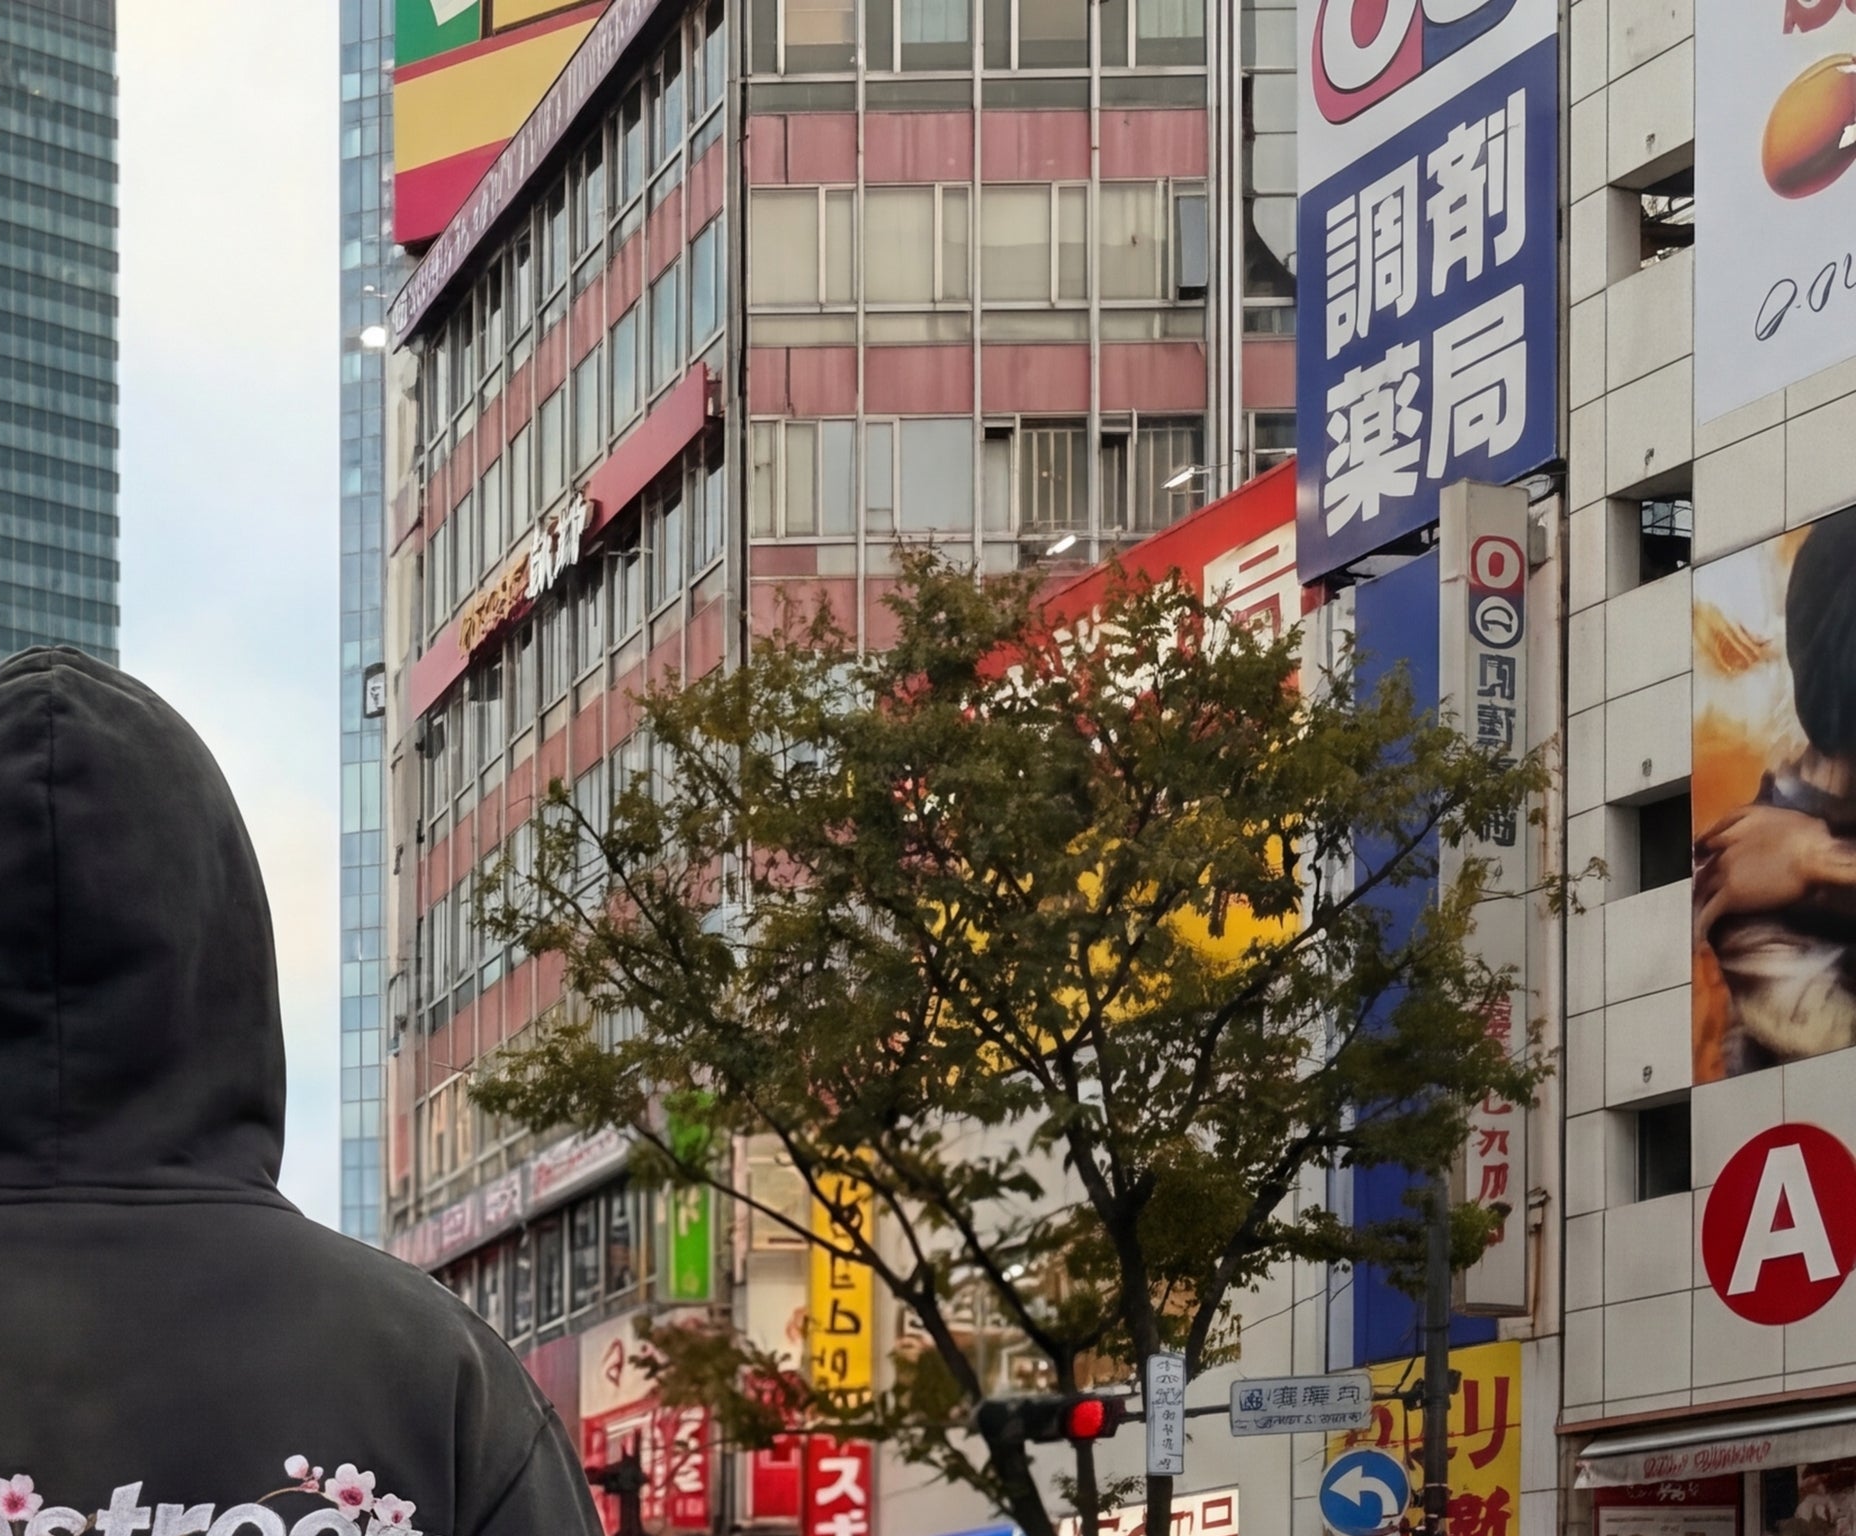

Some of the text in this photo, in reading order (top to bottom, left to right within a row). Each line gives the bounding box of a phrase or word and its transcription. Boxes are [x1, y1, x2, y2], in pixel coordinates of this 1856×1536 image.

[1324, 87, 1527, 361] 調剤
[1324, 283, 1527, 538] 薬局
[1726, 1142, 1841, 1297] A
